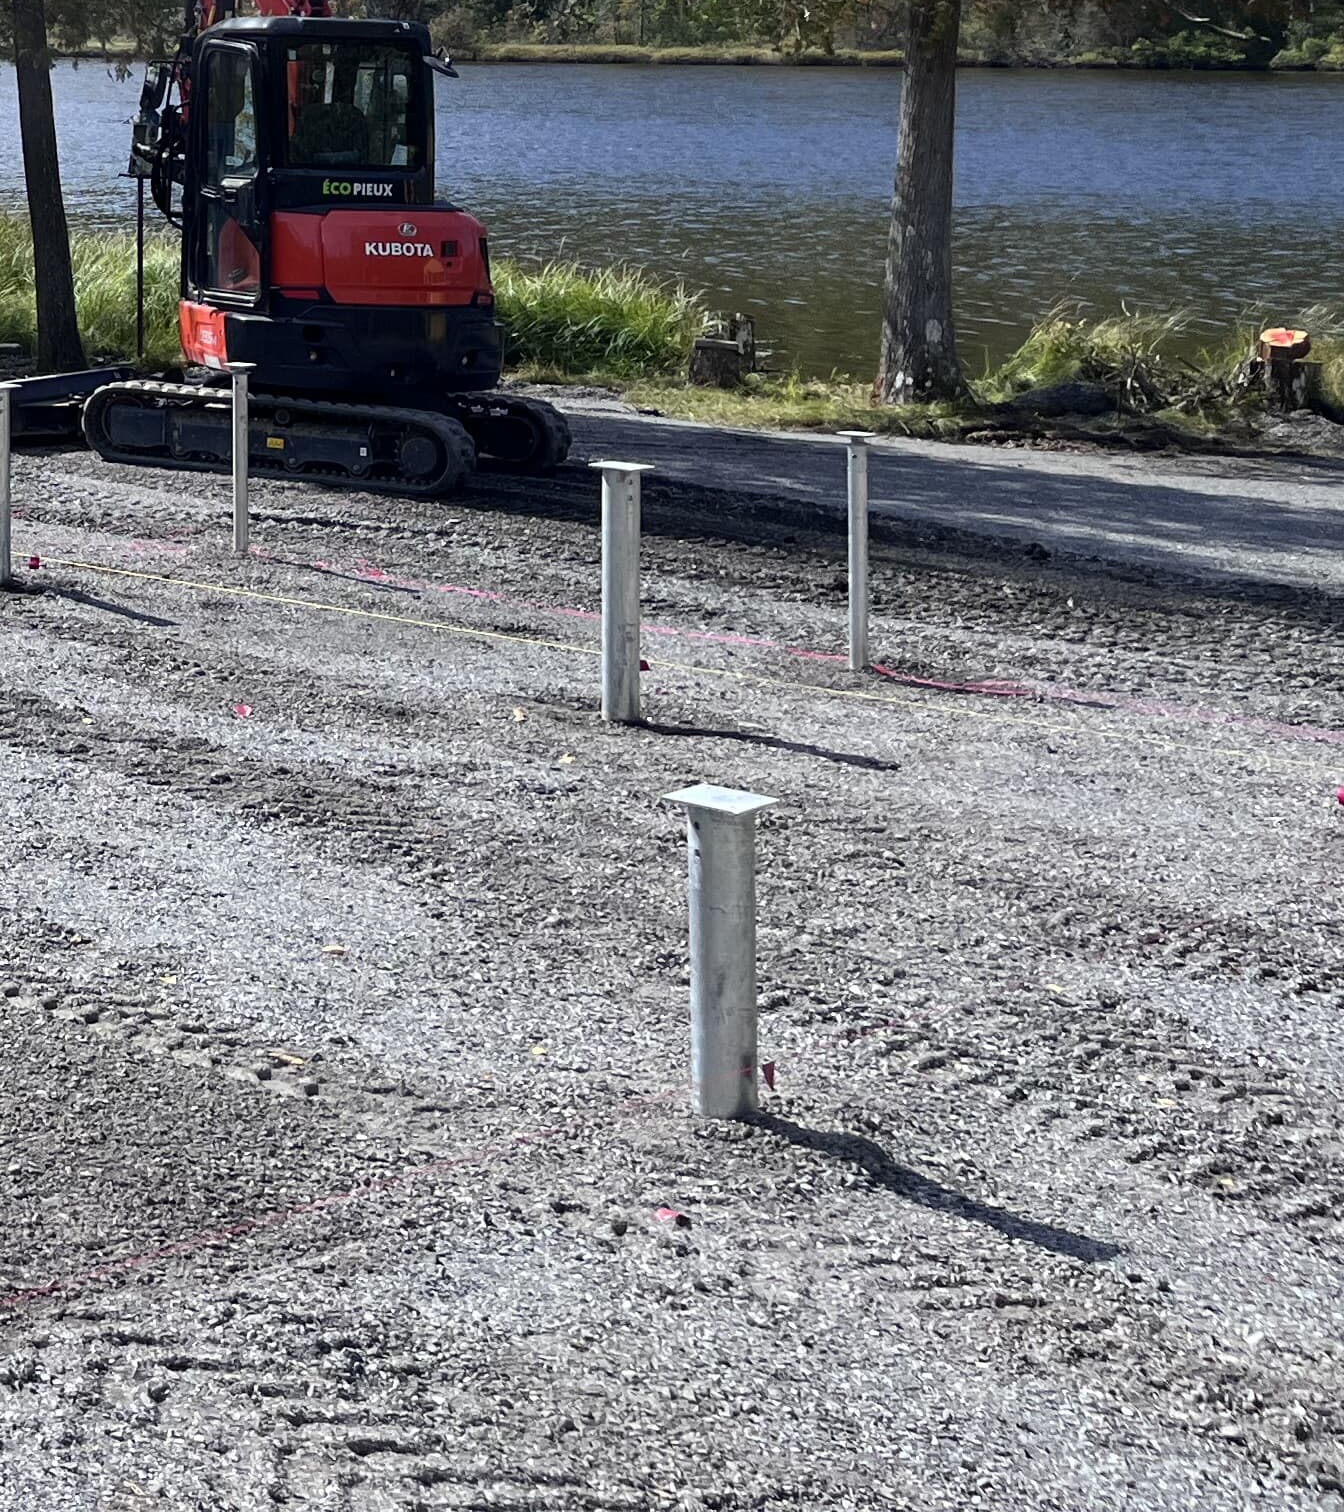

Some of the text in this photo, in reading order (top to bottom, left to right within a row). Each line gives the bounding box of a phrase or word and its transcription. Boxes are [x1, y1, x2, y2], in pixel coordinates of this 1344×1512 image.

[322, 178, 393, 197] ÉCO PIEUX
[365, 242, 434, 257] KUBOTA
